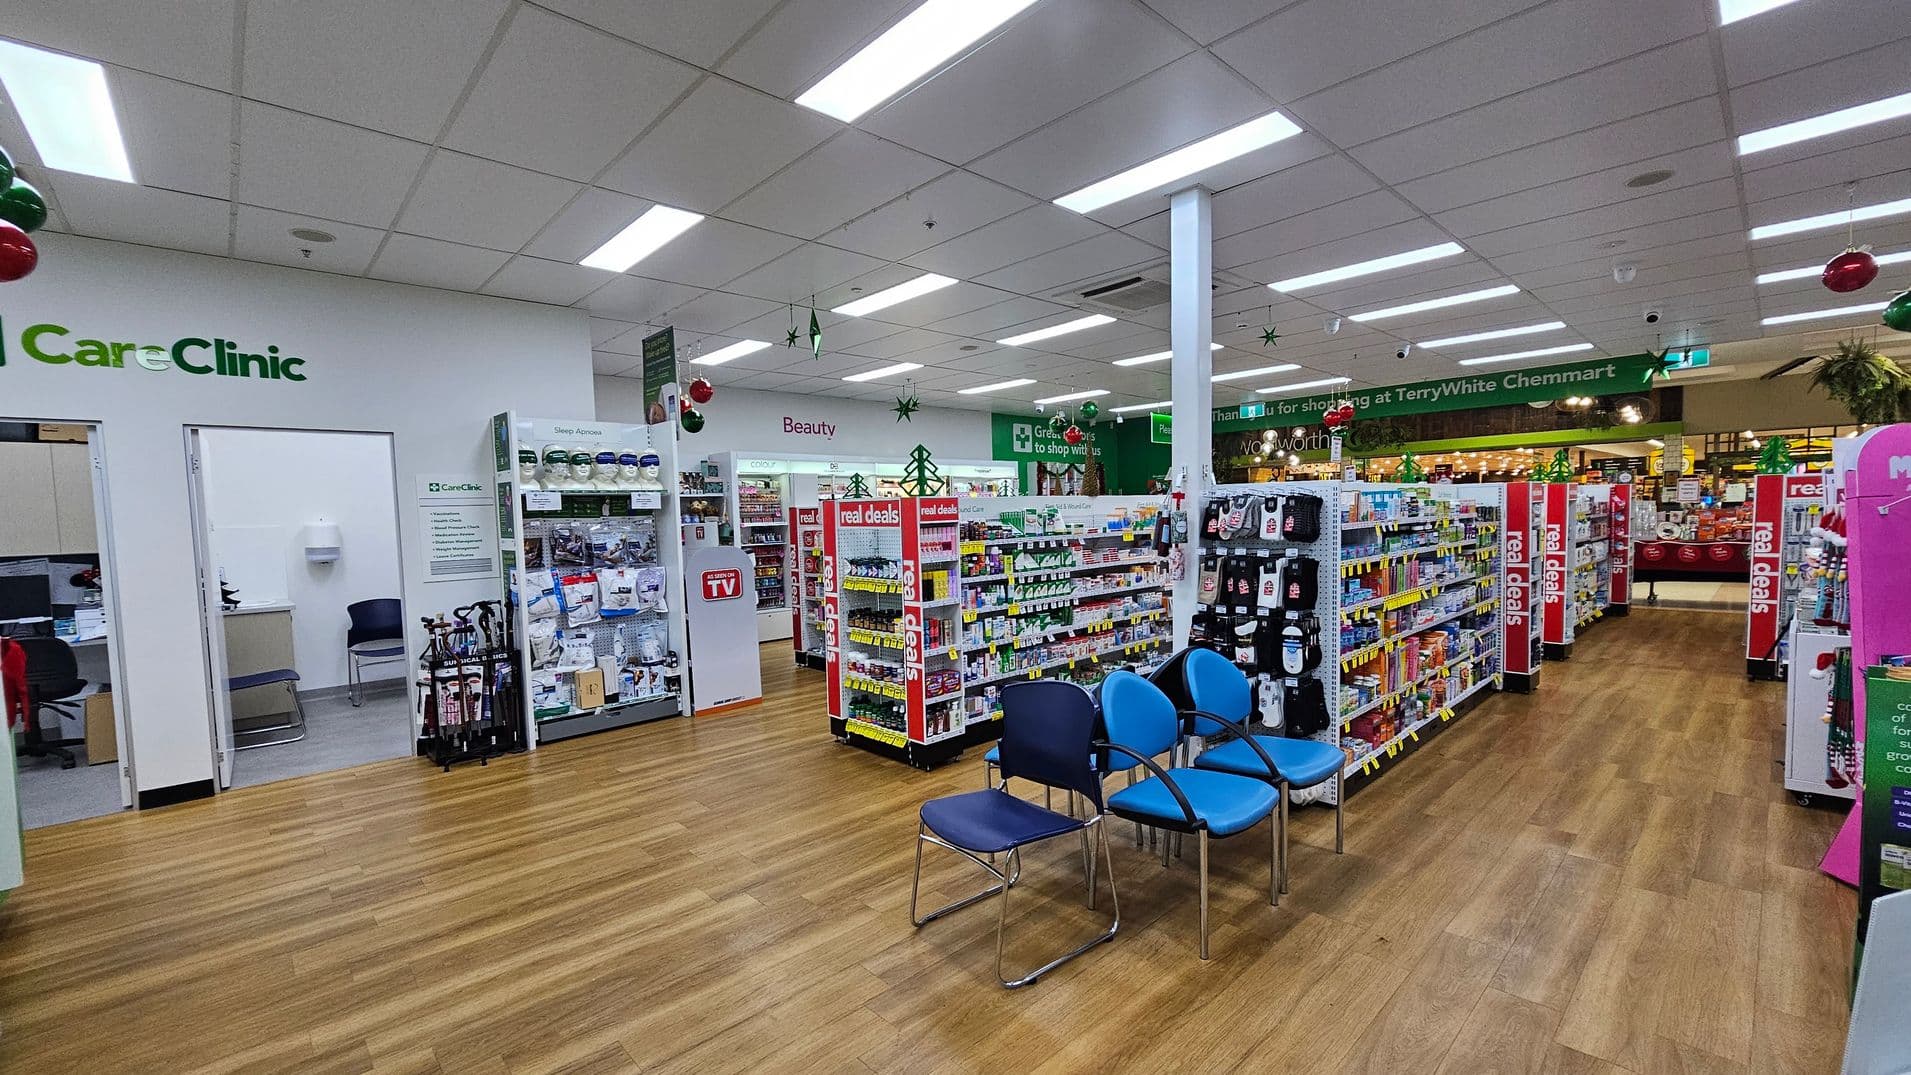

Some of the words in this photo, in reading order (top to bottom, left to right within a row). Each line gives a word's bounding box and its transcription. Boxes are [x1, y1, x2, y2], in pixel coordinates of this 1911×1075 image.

[21, 324, 307, 381] CareClinic
[1212, 409, 1240, 421] Than
[1278, 402, 1298, 414] for
[1375, 391, 1392, 403] at
[1396, 378, 1497, 401] TerryWhite
[1503, 363, 1616, 389] Chemmart
[554, 427, 574, 435] Sleep
[575, 428, 602, 436] Apnoea
[783, 417, 836, 437] Beauty
[1035, 441, 1045, 453] to
[1047, 441, 1069, 457] shop
[1092, 447, 1102, 456] us
[800, 510, 815, 523] real
[840, 505, 862, 524] real
[864, 504, 900, 524] deals
[920, 504, 936, 515] real
[937, 502, 958, 515] deals
[1507, 531, 1529, 567] real
[1547, 524, 1565, 555] real
[1755, 522, 1780, 557] real
[790, 544, 799, 572] real
[708, 578, 735, 596] TV
[824, 556, 838, 597] real
[904, 560, 920, 606] real
[1546, 559, 1566, 604] deals
[1752, 563, 1779, 613] deals
[791, 575, 800, 615] deals
[1507, 573, 1528, 625] deals
[825, 603, 839, 663] deals
[904, 613, 923, 681] deals
[1892, 713, 1907, 723] of
